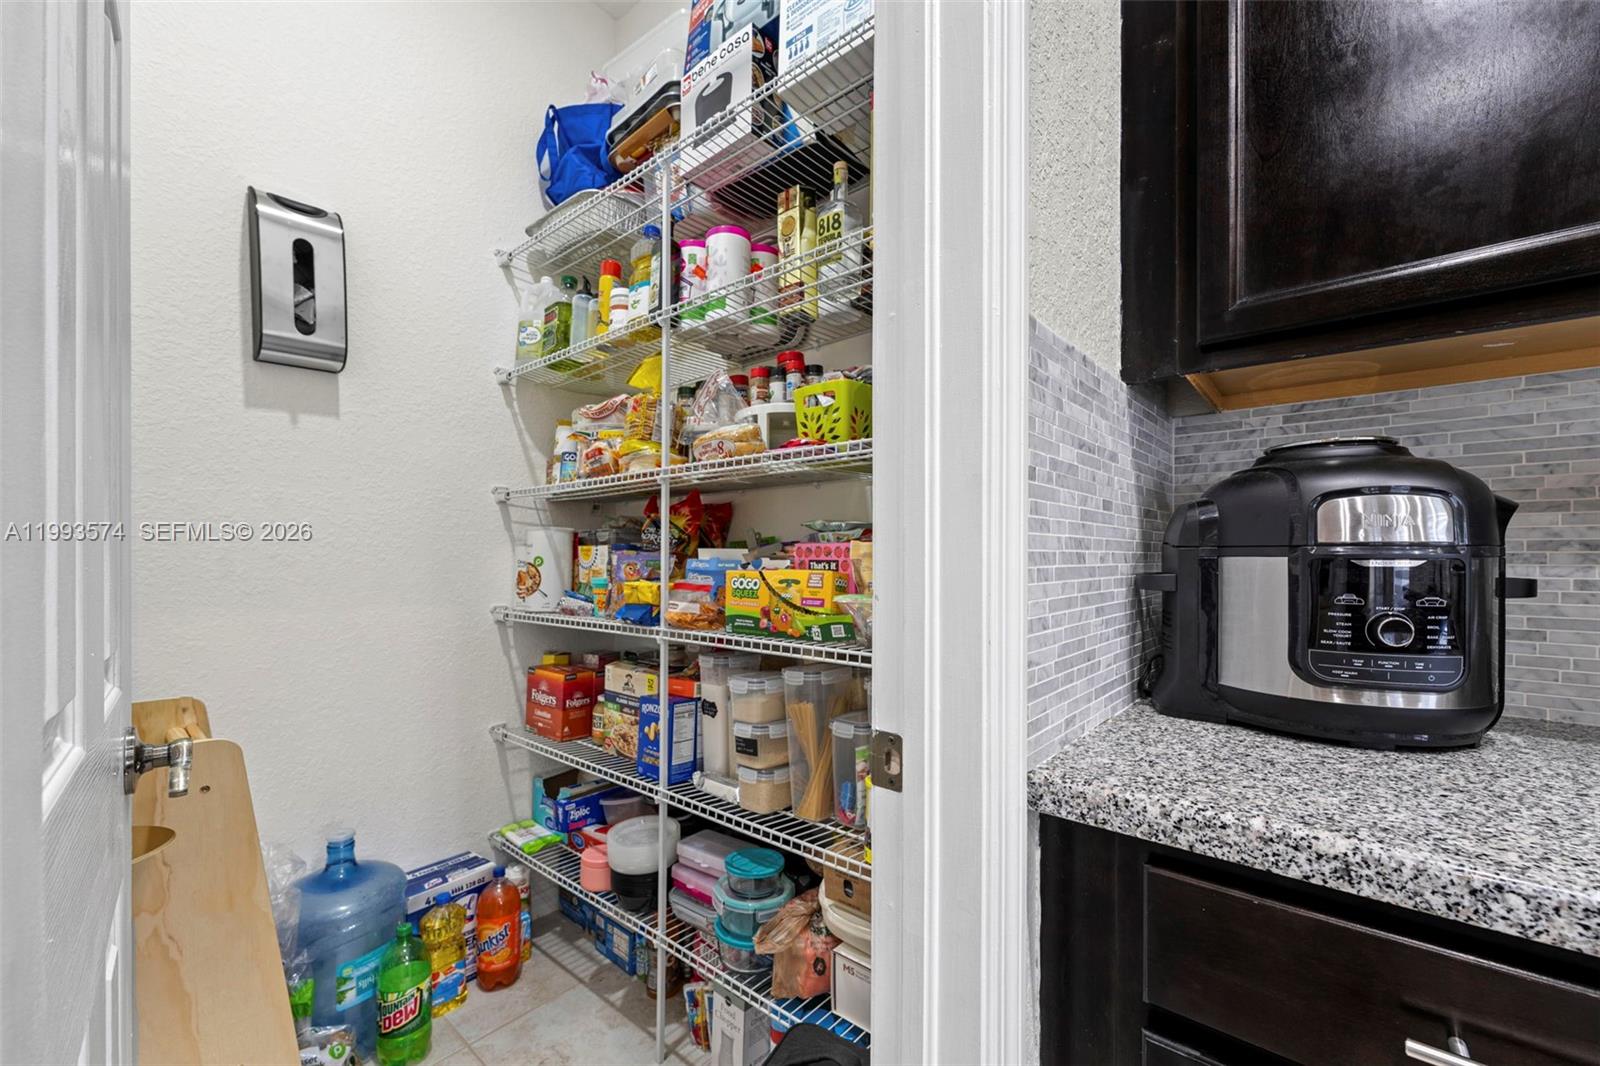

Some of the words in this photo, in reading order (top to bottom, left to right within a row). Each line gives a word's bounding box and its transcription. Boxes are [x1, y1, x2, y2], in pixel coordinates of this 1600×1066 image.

[692, 56, 718, 82] bene
[720, 31, 750, 59] casa
[818, 212, 842, 237] 818
[718, 440, 724, 455] 8
[1363, 514, 1416, 530] NINJA
[731, 577, 760, 590] GOGO
[531, 688, 557, 708] Folgers
[566, 698, 590, 708] Folgers
[569, 806, 590, 821] Ziploc
[842, 964, 855, 976] MS
